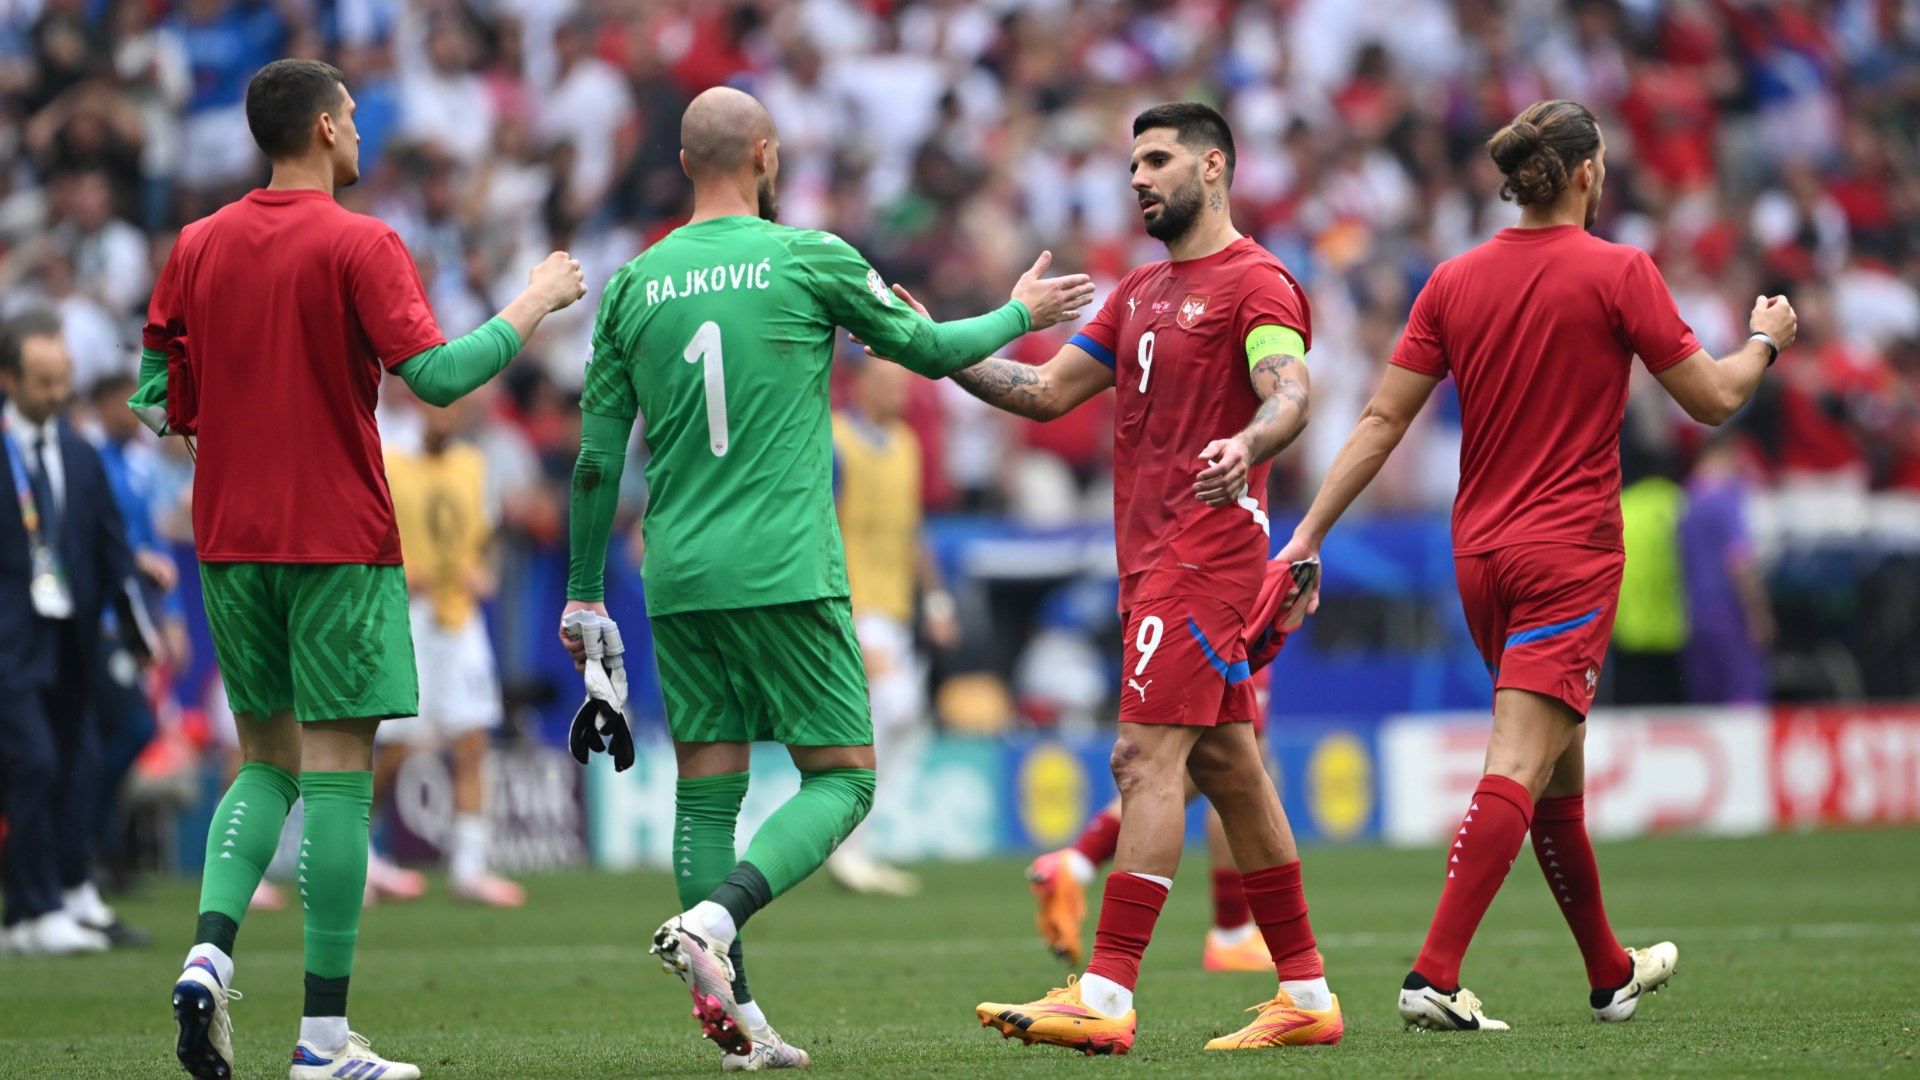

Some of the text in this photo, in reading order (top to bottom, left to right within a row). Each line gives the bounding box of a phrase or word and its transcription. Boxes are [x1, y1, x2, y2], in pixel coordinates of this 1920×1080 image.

[646, 257, 771, 306] RAJKOVIĆ
[683, 320, 729, 458] 1
[1138, 331, 1156, 394] 9
[1134, 615, 1164, 676] 9
